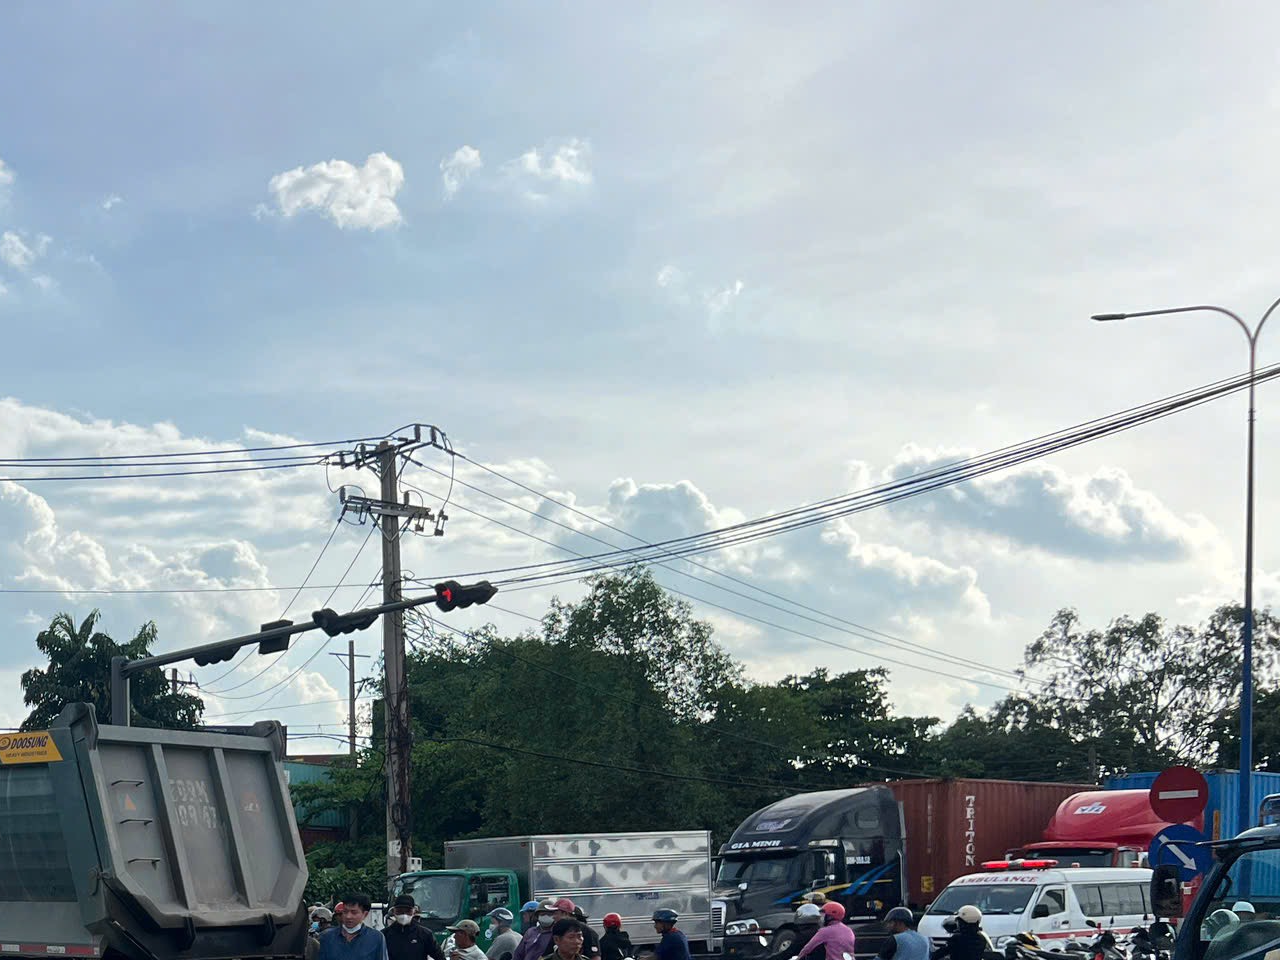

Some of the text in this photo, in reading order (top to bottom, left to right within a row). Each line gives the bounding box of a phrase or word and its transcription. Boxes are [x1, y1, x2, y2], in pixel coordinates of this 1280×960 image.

[10, 735, 49, 750] DOOSUNG
[965, 795, 976, 867] TRITON
[731, 840, 781, 850] GIA MINH
[956, 876, 1039, 884] AMBULANCE
